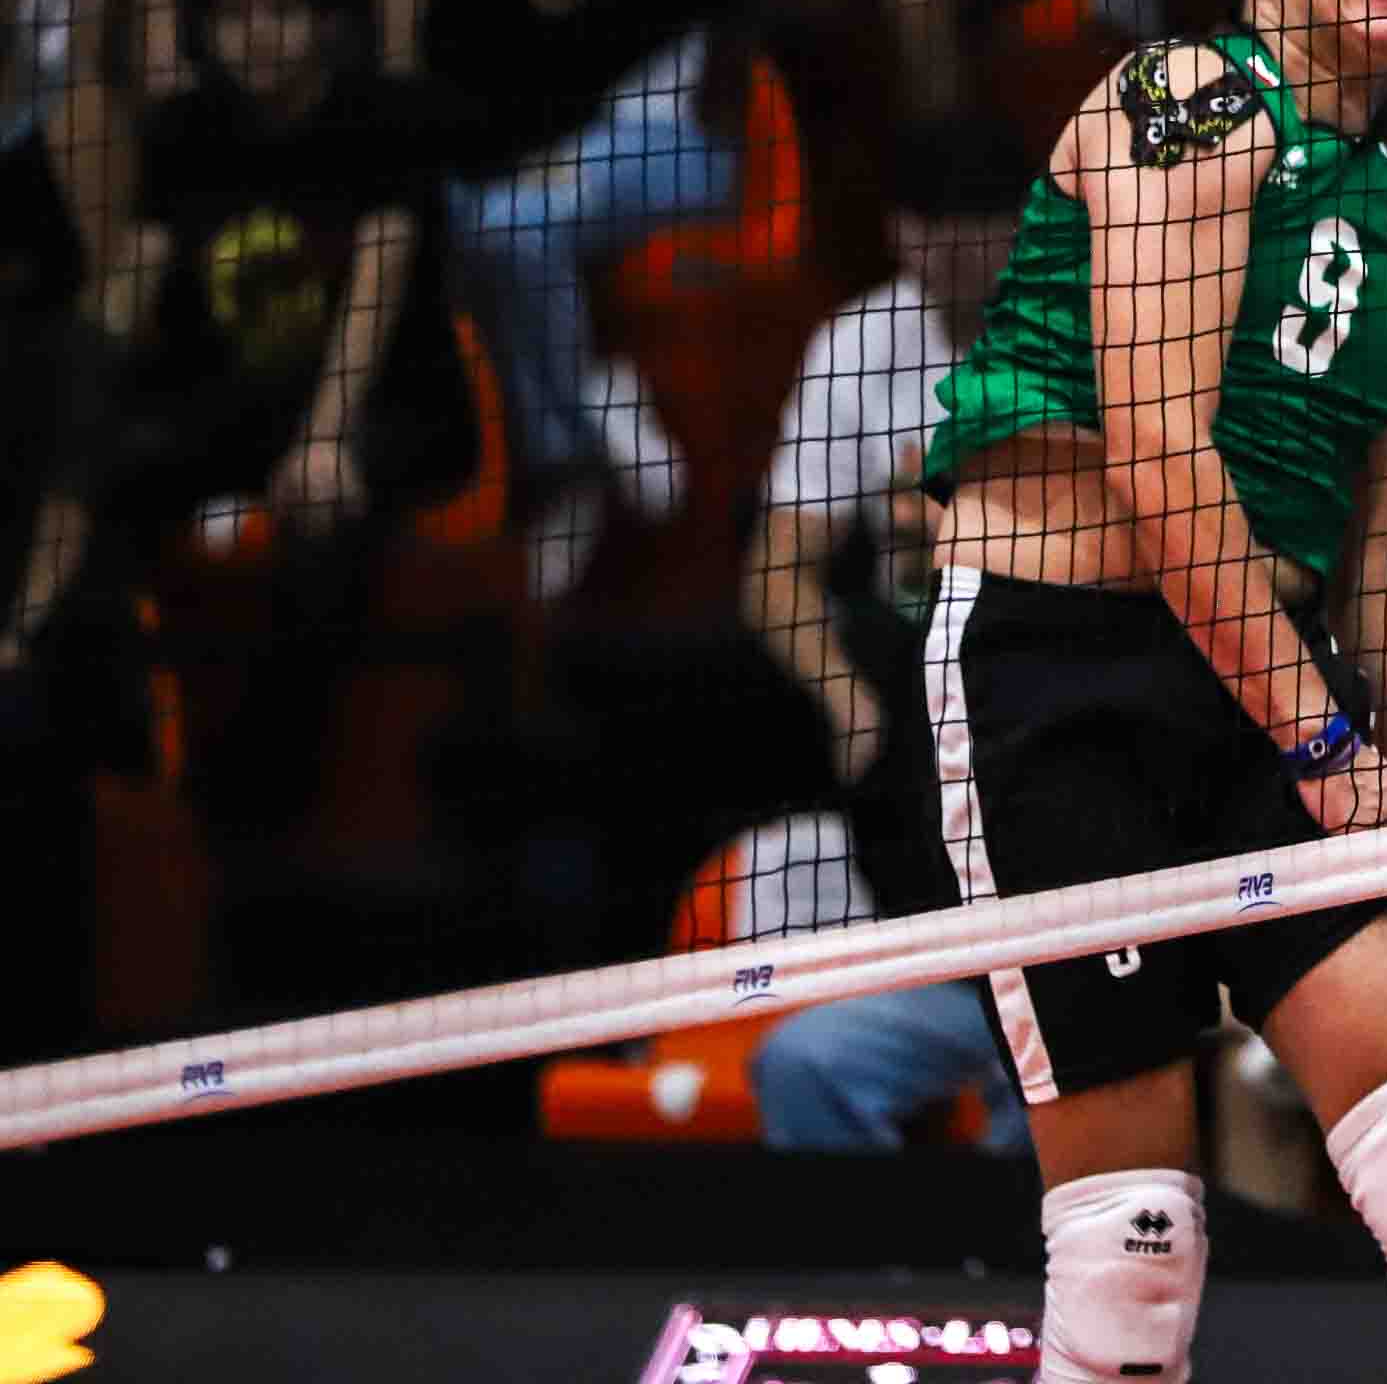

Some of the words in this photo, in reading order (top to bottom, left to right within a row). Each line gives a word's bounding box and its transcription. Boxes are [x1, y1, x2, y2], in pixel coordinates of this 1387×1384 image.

[1272, 216, 1368, 378] 9
[1238, 873, 1273, 900] FIVB
[734, 964, 774, 992] FIVB
[181, 1060, 224, 1089] FIVB
